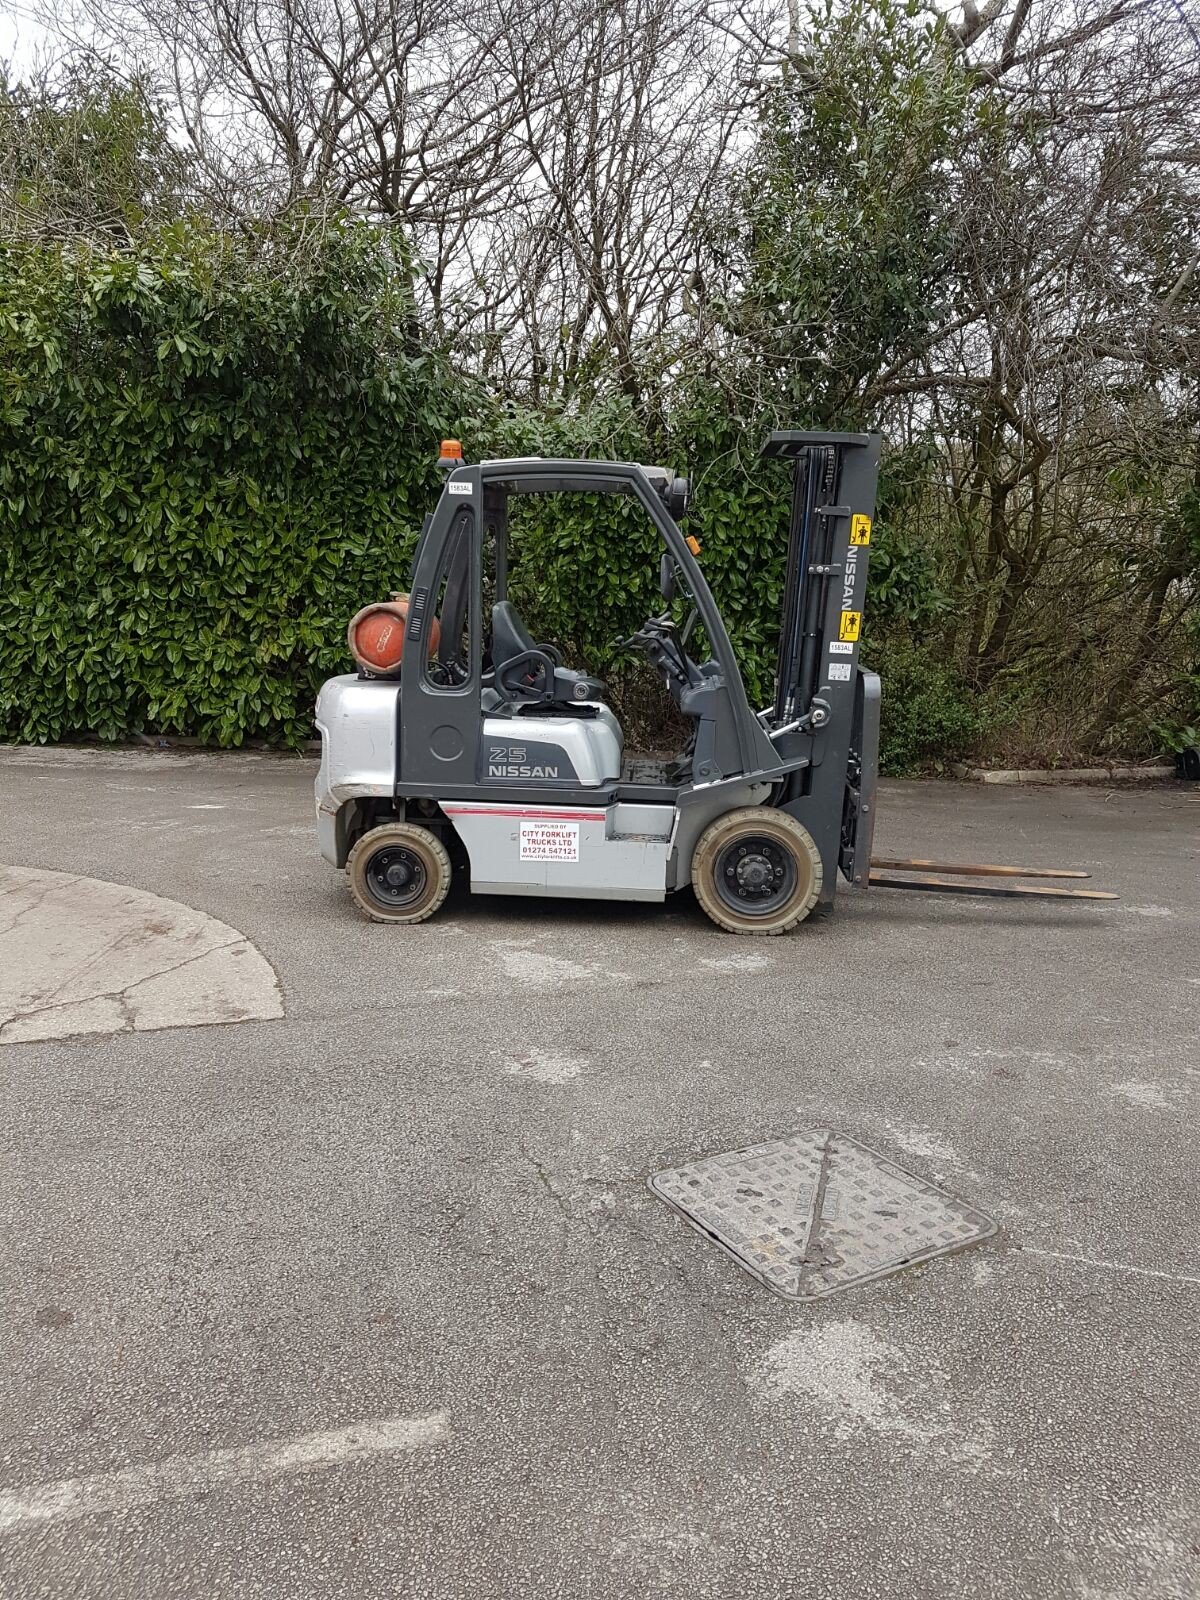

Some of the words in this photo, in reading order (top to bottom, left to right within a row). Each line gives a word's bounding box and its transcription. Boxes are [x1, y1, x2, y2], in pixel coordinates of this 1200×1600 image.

[841, 545, 859, 611] NISSAN
[489, 747, 527, 762] 25
[488, 765, 558, 778] NISSAN
[527, 838, 557, 846] TRUCKS
[548, 847, 576, 855] 547121
